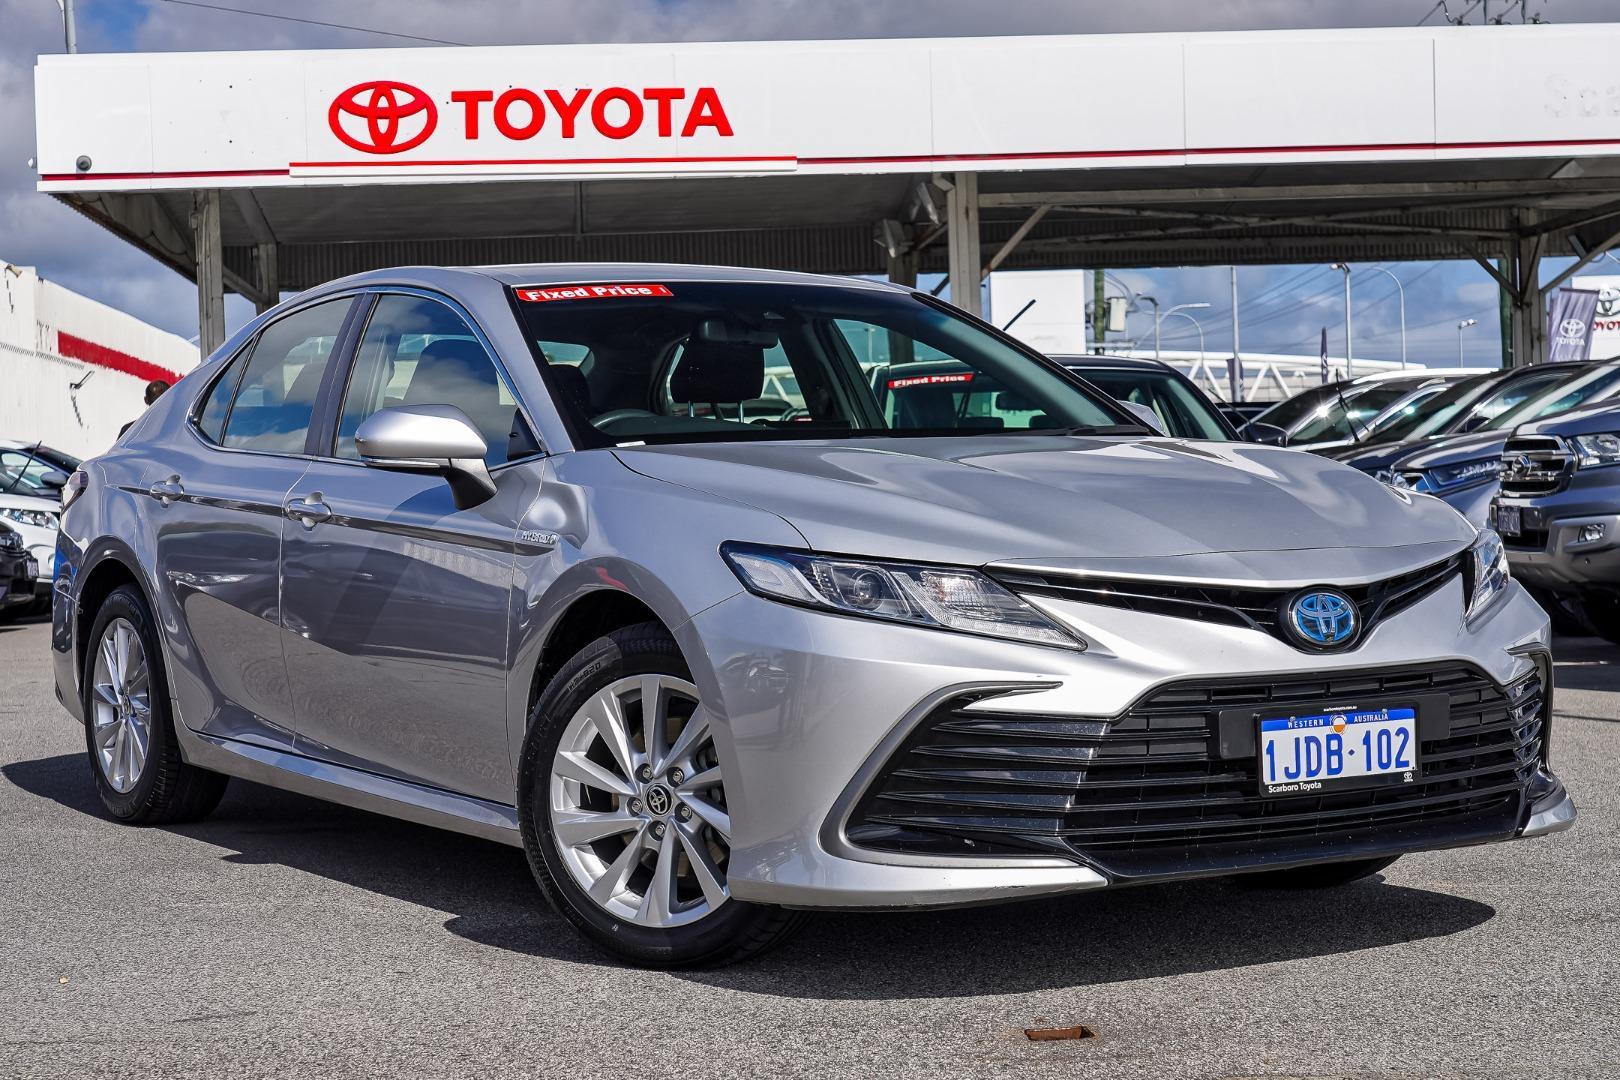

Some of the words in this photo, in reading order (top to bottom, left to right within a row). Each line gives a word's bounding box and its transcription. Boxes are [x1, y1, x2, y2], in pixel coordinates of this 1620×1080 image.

[451, 87, 734, 141] TOYOTA
[525, 287, 590, 301] Fixed
[592, 286, 653, 296] Price
[893, 377, 928, 388] Fixed
[931, 375, 966, 383] Price
[1287, 718, 1324, 729] WESTERN
[1353, 713, 1389, 723] AUSTRALIA
[1268, 783, 1299, 794] Scarboro
[1299, 781, 1322, 792] Toyota
